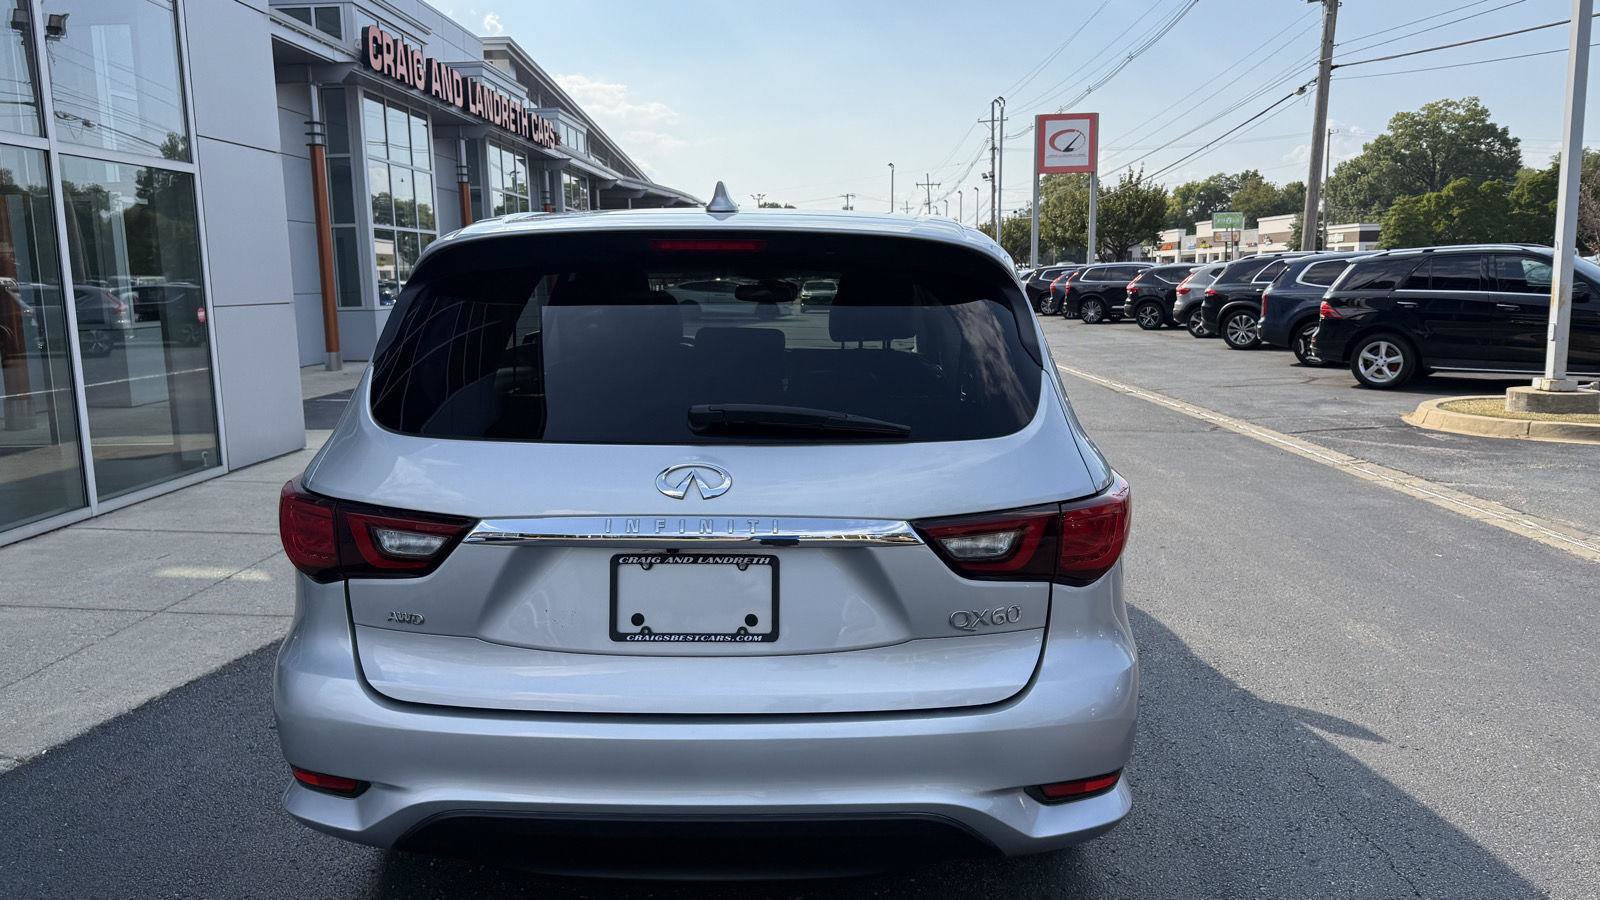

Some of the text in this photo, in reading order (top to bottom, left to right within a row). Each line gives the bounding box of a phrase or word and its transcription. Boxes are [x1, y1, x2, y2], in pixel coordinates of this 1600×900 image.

[366, 25, 557, 149] CRAIG AND LANDRETH CARS
[604, 518, 780, 535] INFINITI
[618, 555, 771, 565] CRAIG AND LANDRETH
[387, 610, 426, 626] AWD
[948, 604, 1022, 632] QX60
[626, 633, 764, 643] CRAIGSBESTCARS.COM
